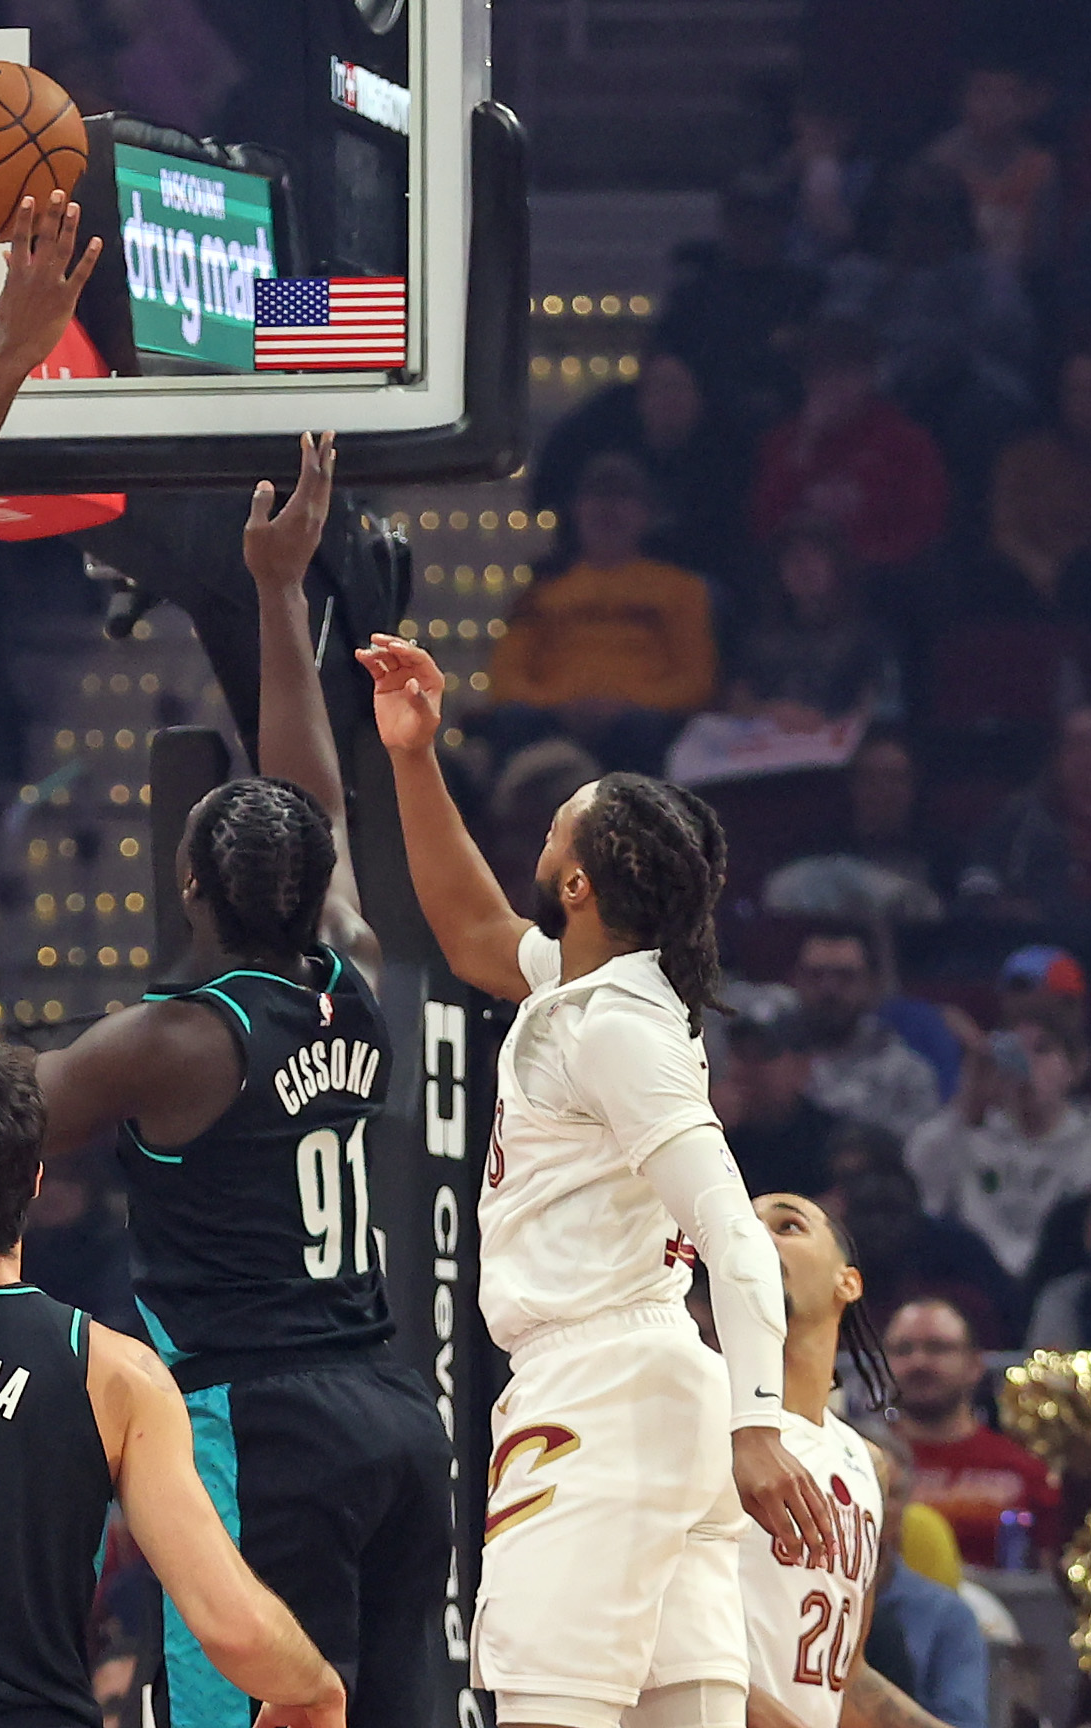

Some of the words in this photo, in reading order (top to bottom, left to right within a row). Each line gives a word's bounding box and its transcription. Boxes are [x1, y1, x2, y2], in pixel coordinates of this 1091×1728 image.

[124, 190, 202, 345] drug
[274, 1037, 380, 1117] CISSOKO
[296, 1117, 370, 1280] 91
